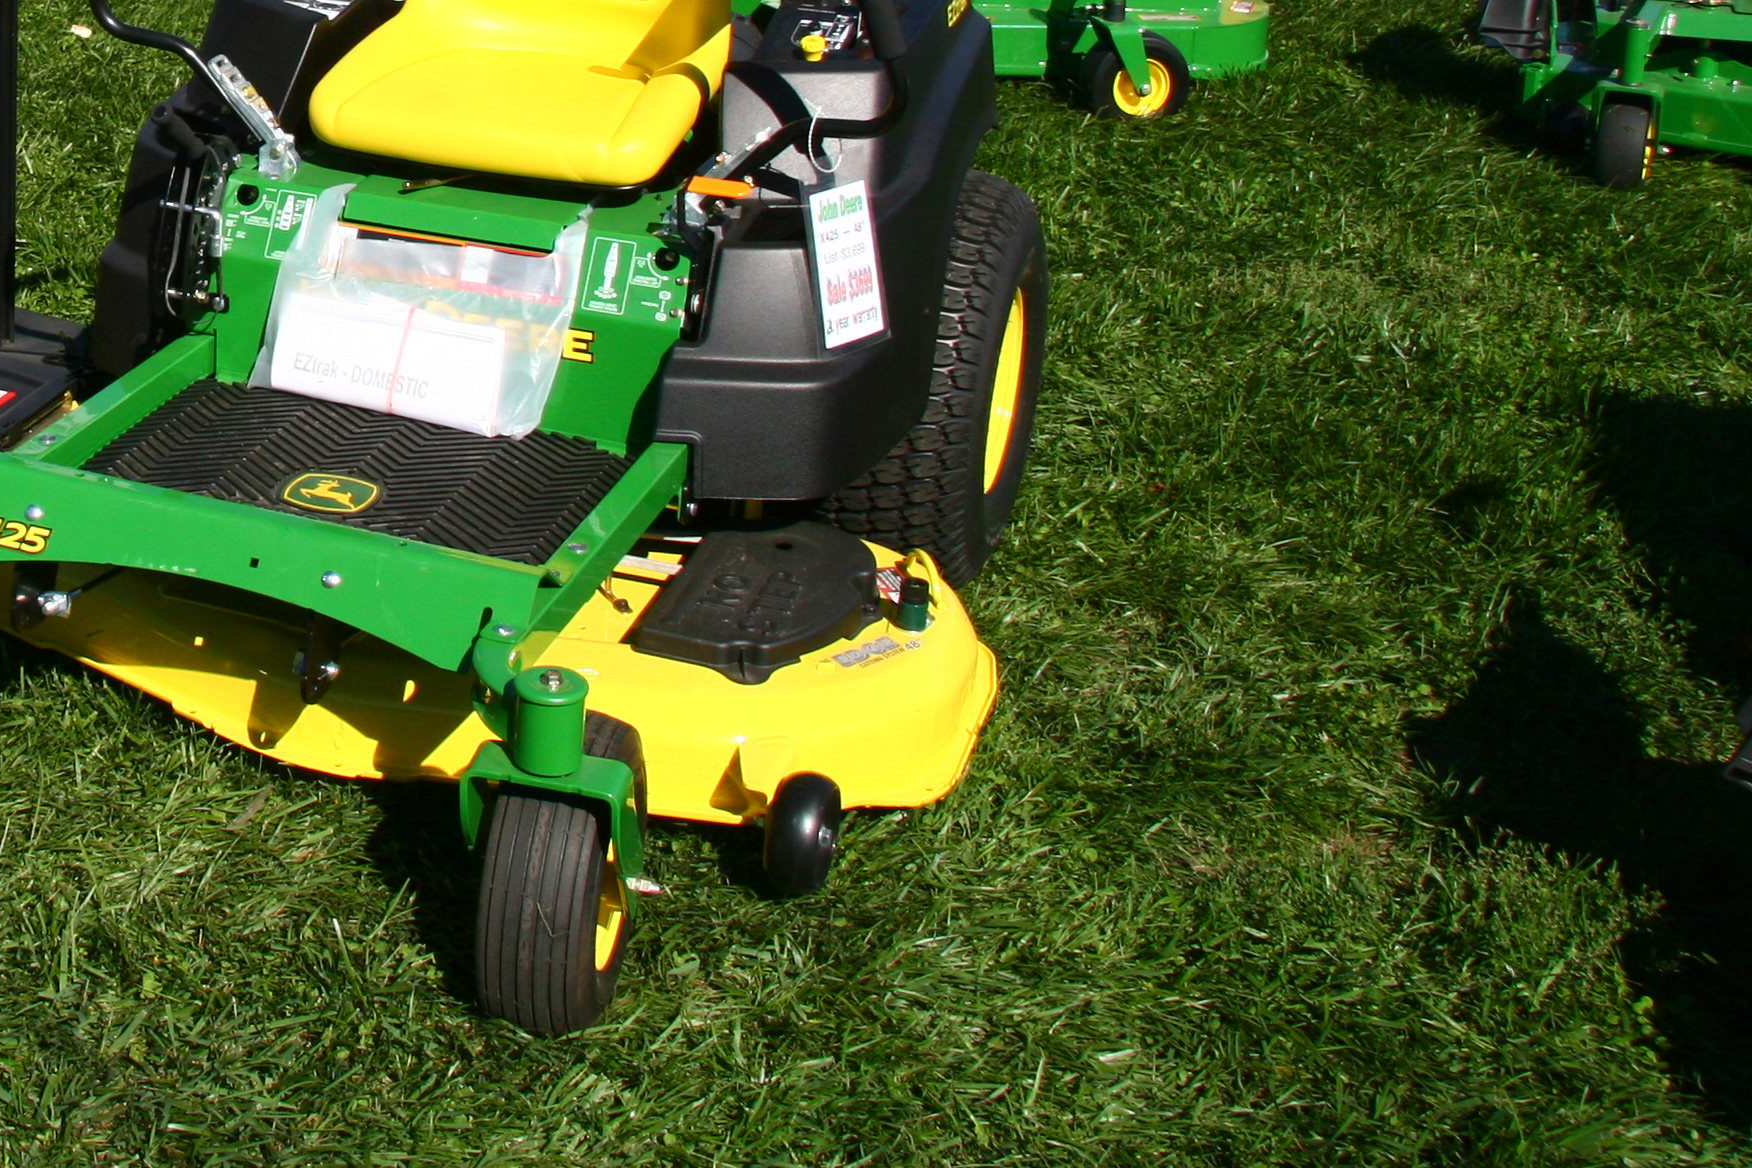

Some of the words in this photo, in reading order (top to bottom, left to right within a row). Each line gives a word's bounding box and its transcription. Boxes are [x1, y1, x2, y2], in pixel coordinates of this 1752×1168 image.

[818, 198, 839, 223] John
[839, 193, 864, 216] Deere
[824, 249, 838, 265] List
[826, 274, 847, 306] Sale
[836, 316, 850, 335] year
[853, 305, 878, 325] warranty
[293, 350, 338, 380] EZtrak
[350, 367, 430, 400] DOMESTIC
